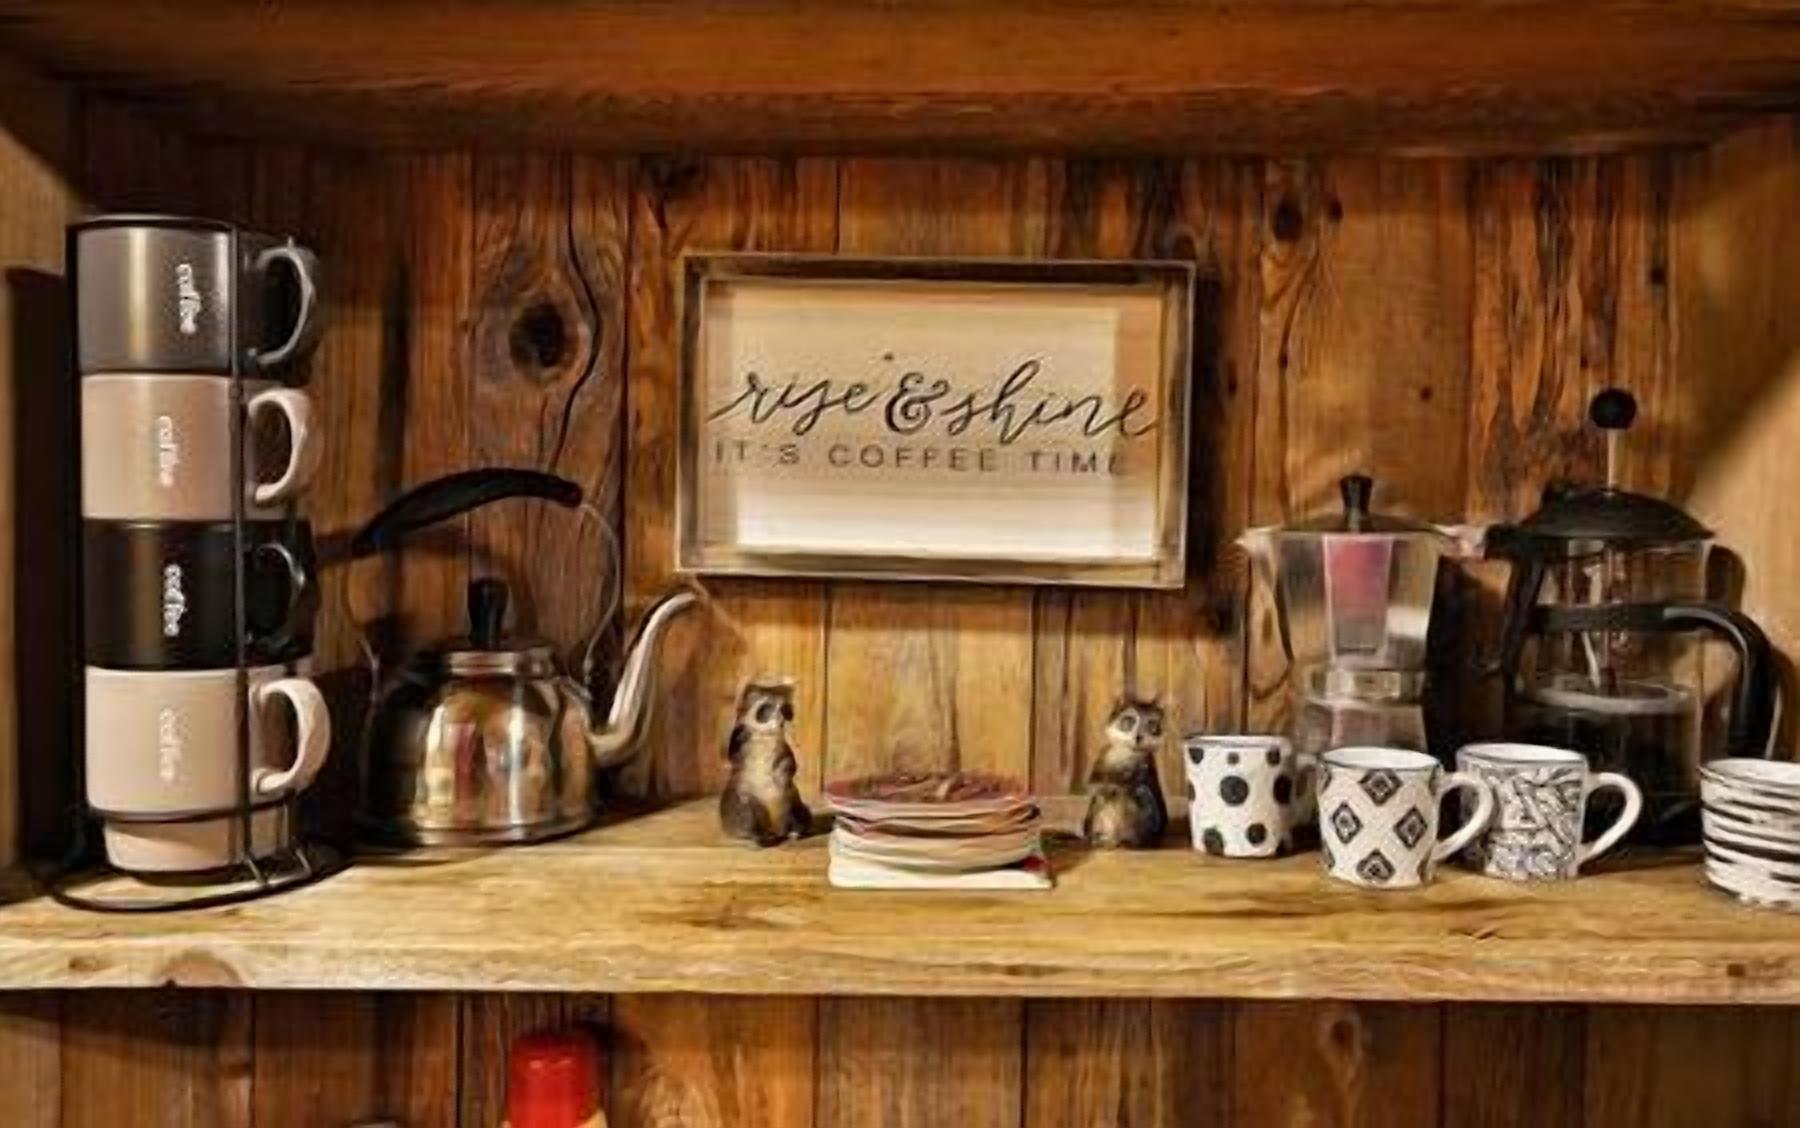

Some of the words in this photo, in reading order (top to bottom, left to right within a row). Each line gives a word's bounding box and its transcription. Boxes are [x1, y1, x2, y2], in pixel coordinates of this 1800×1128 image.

[885, 371, 951, 434] &
[942, 358, 1160, 446] shine
[715, 439, 800, 466] IT'S
[827, 442, 997, 473] COFFEE
